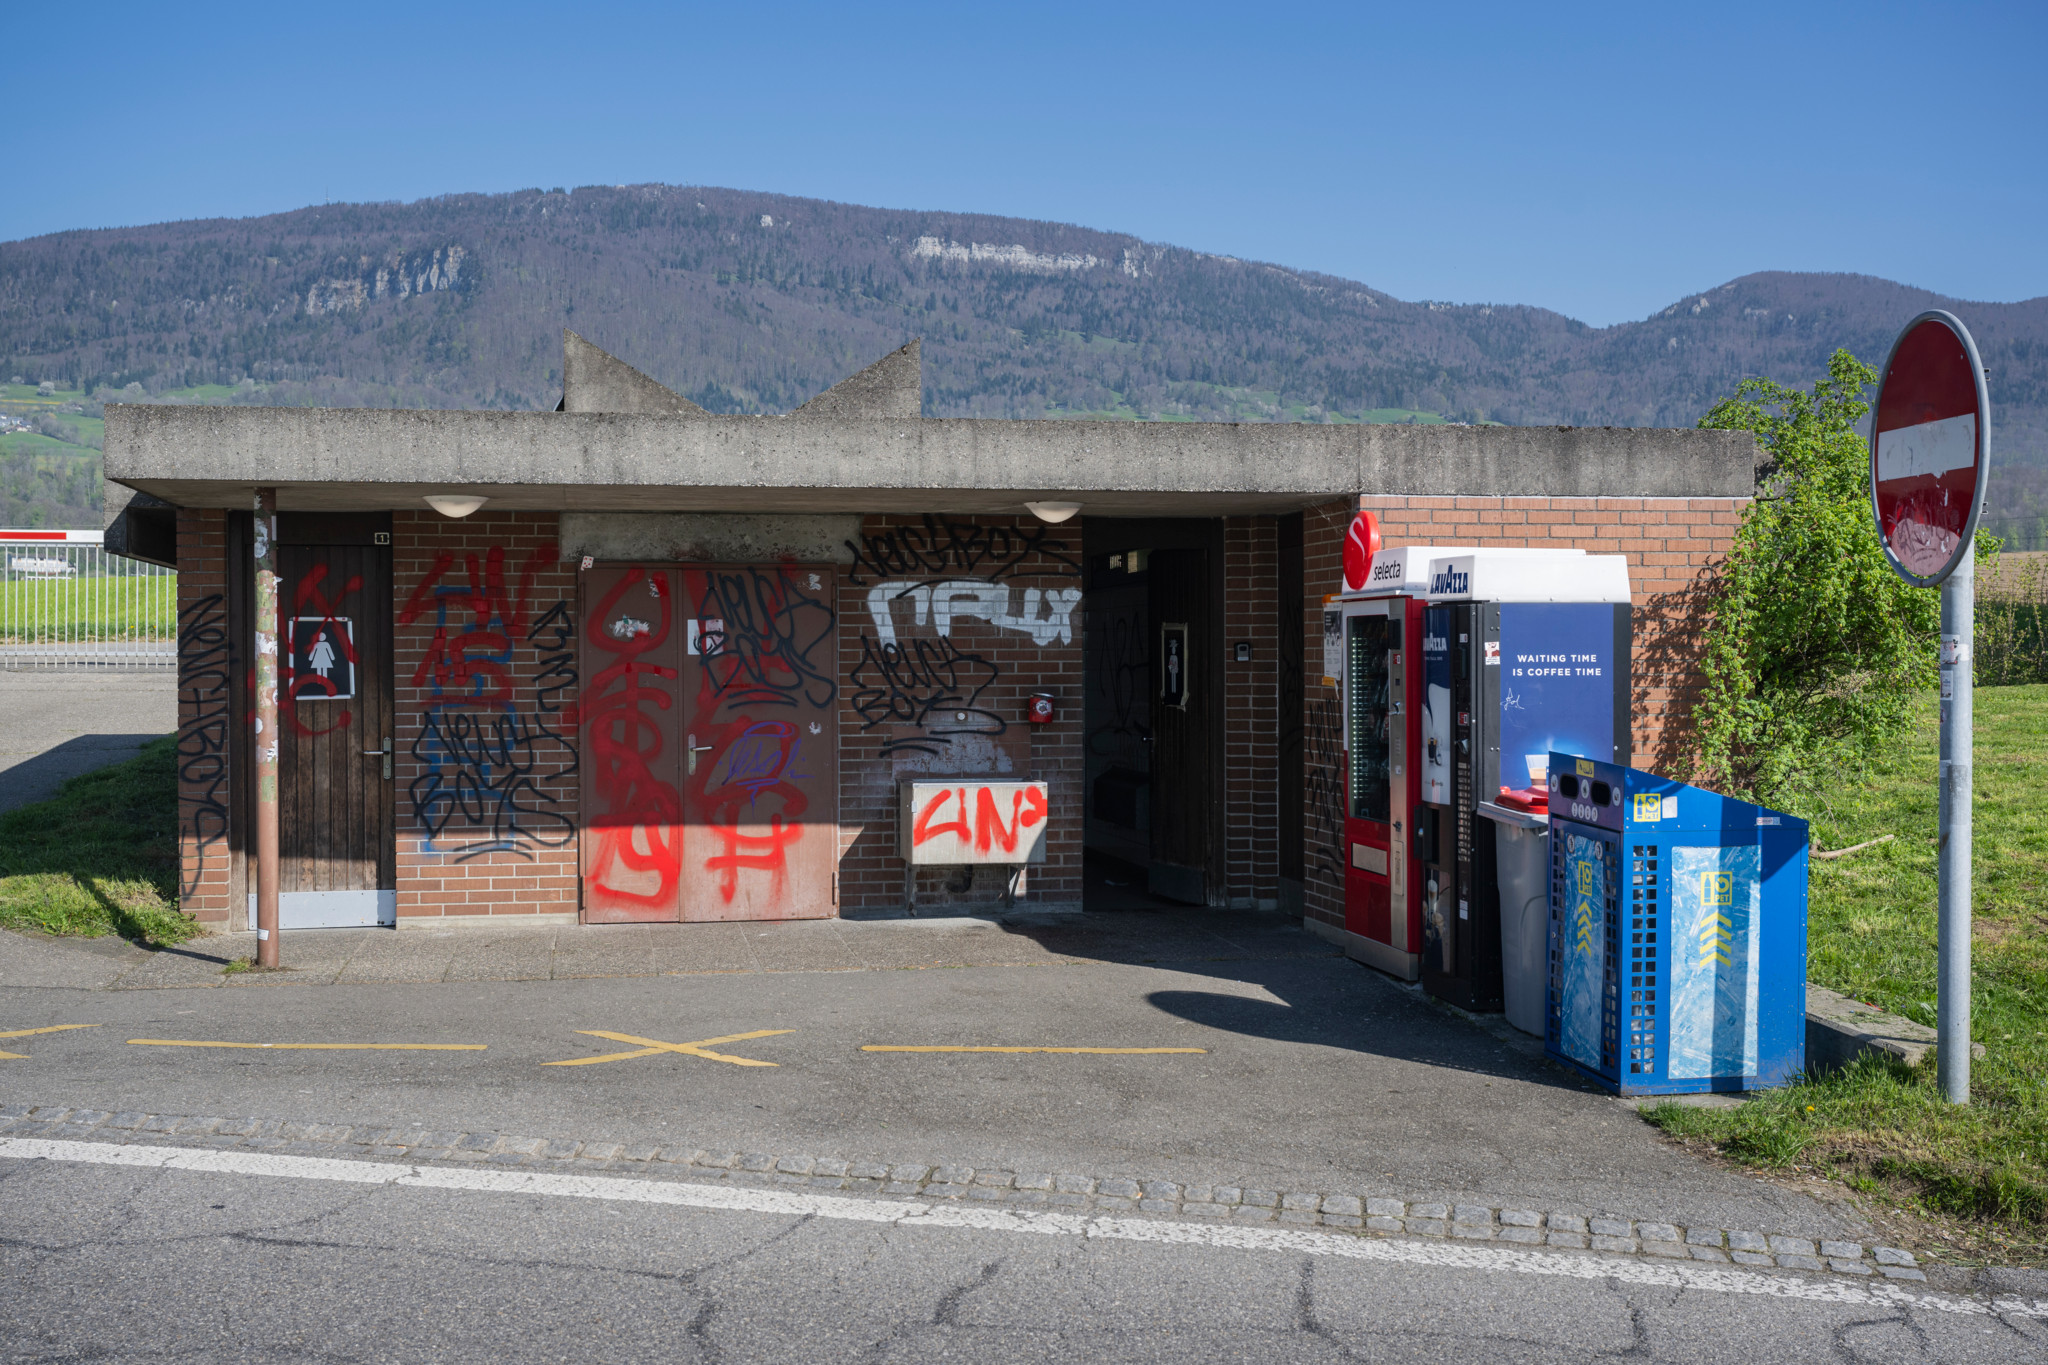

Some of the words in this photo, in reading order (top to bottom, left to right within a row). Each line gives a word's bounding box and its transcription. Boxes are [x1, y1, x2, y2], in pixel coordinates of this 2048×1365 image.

[380, 535, 385, 543] 1
[1373, 560, 1401, 581] selecta
[1429, 564, 1468, 595] LAVAZZA
[1517, 654, 1566, 663] WAITING
[1570, 654, 1597, 663] TIME
[1512, 668, 1523, 677] IS
[1527, 668, 1571, 677] COFFEE
[1575, 668, 1602, 677] TIME
[1714, 894, 1729, 902] PET
